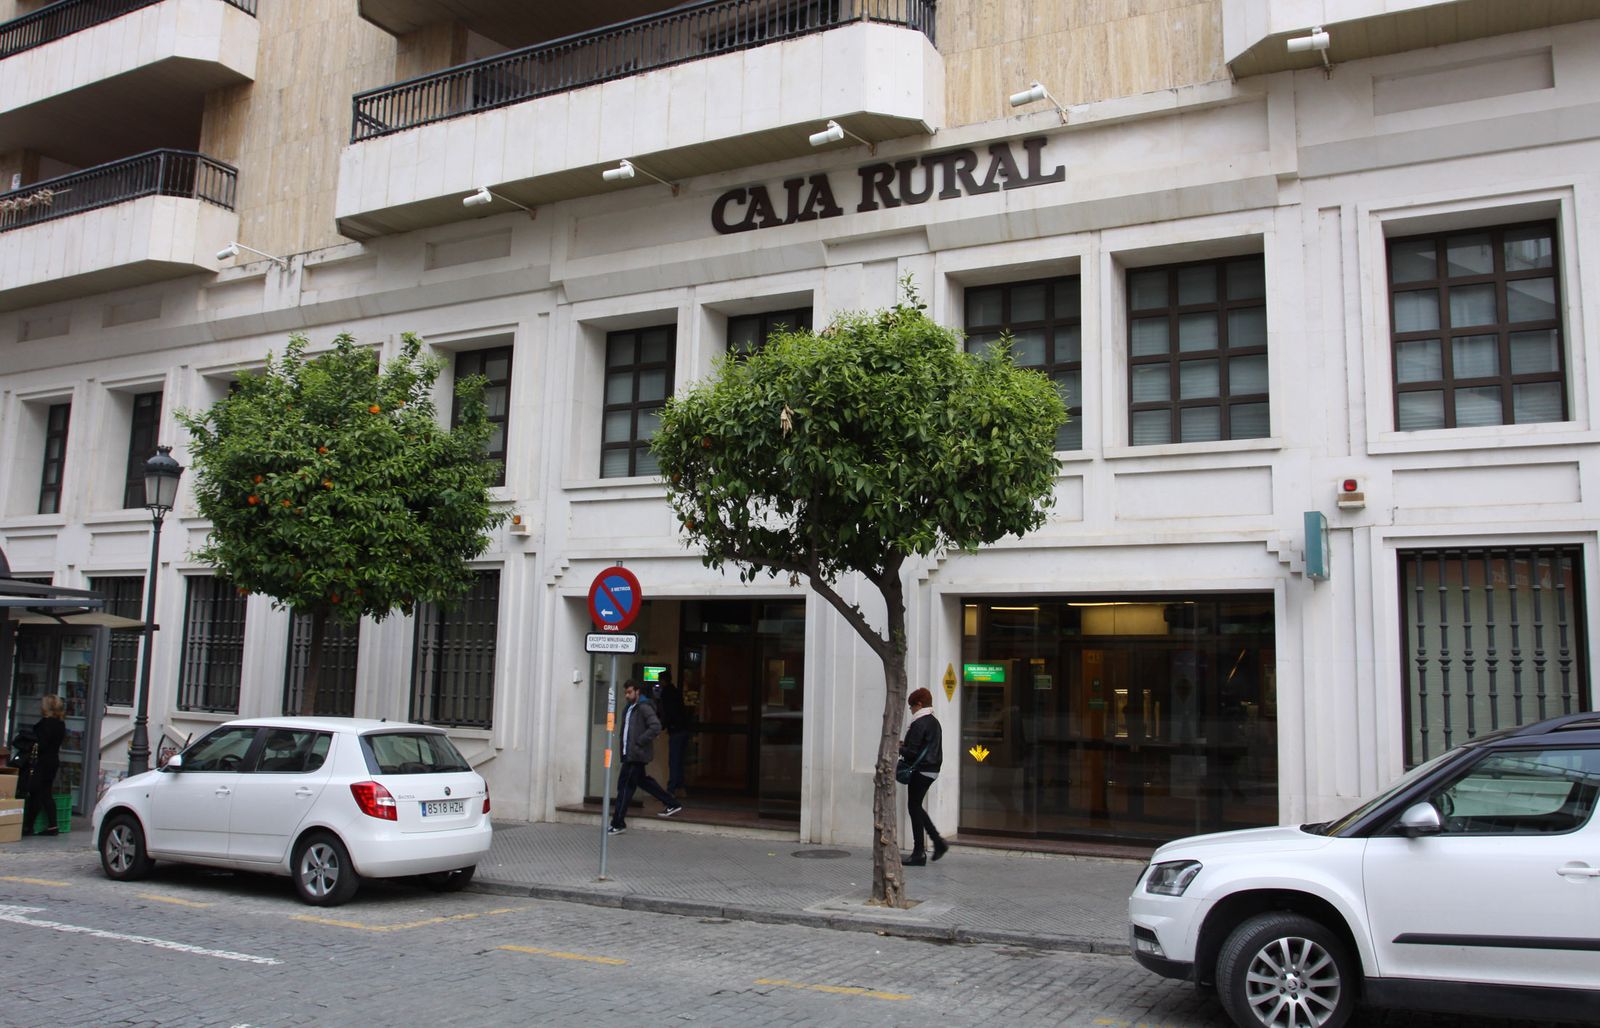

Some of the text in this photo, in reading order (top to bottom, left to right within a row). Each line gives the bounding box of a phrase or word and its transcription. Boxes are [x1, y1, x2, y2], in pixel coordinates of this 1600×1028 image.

[711, 137, 1066, 235] CAJA RURAL
[427, 801, 464, 814] 8518 HZH
